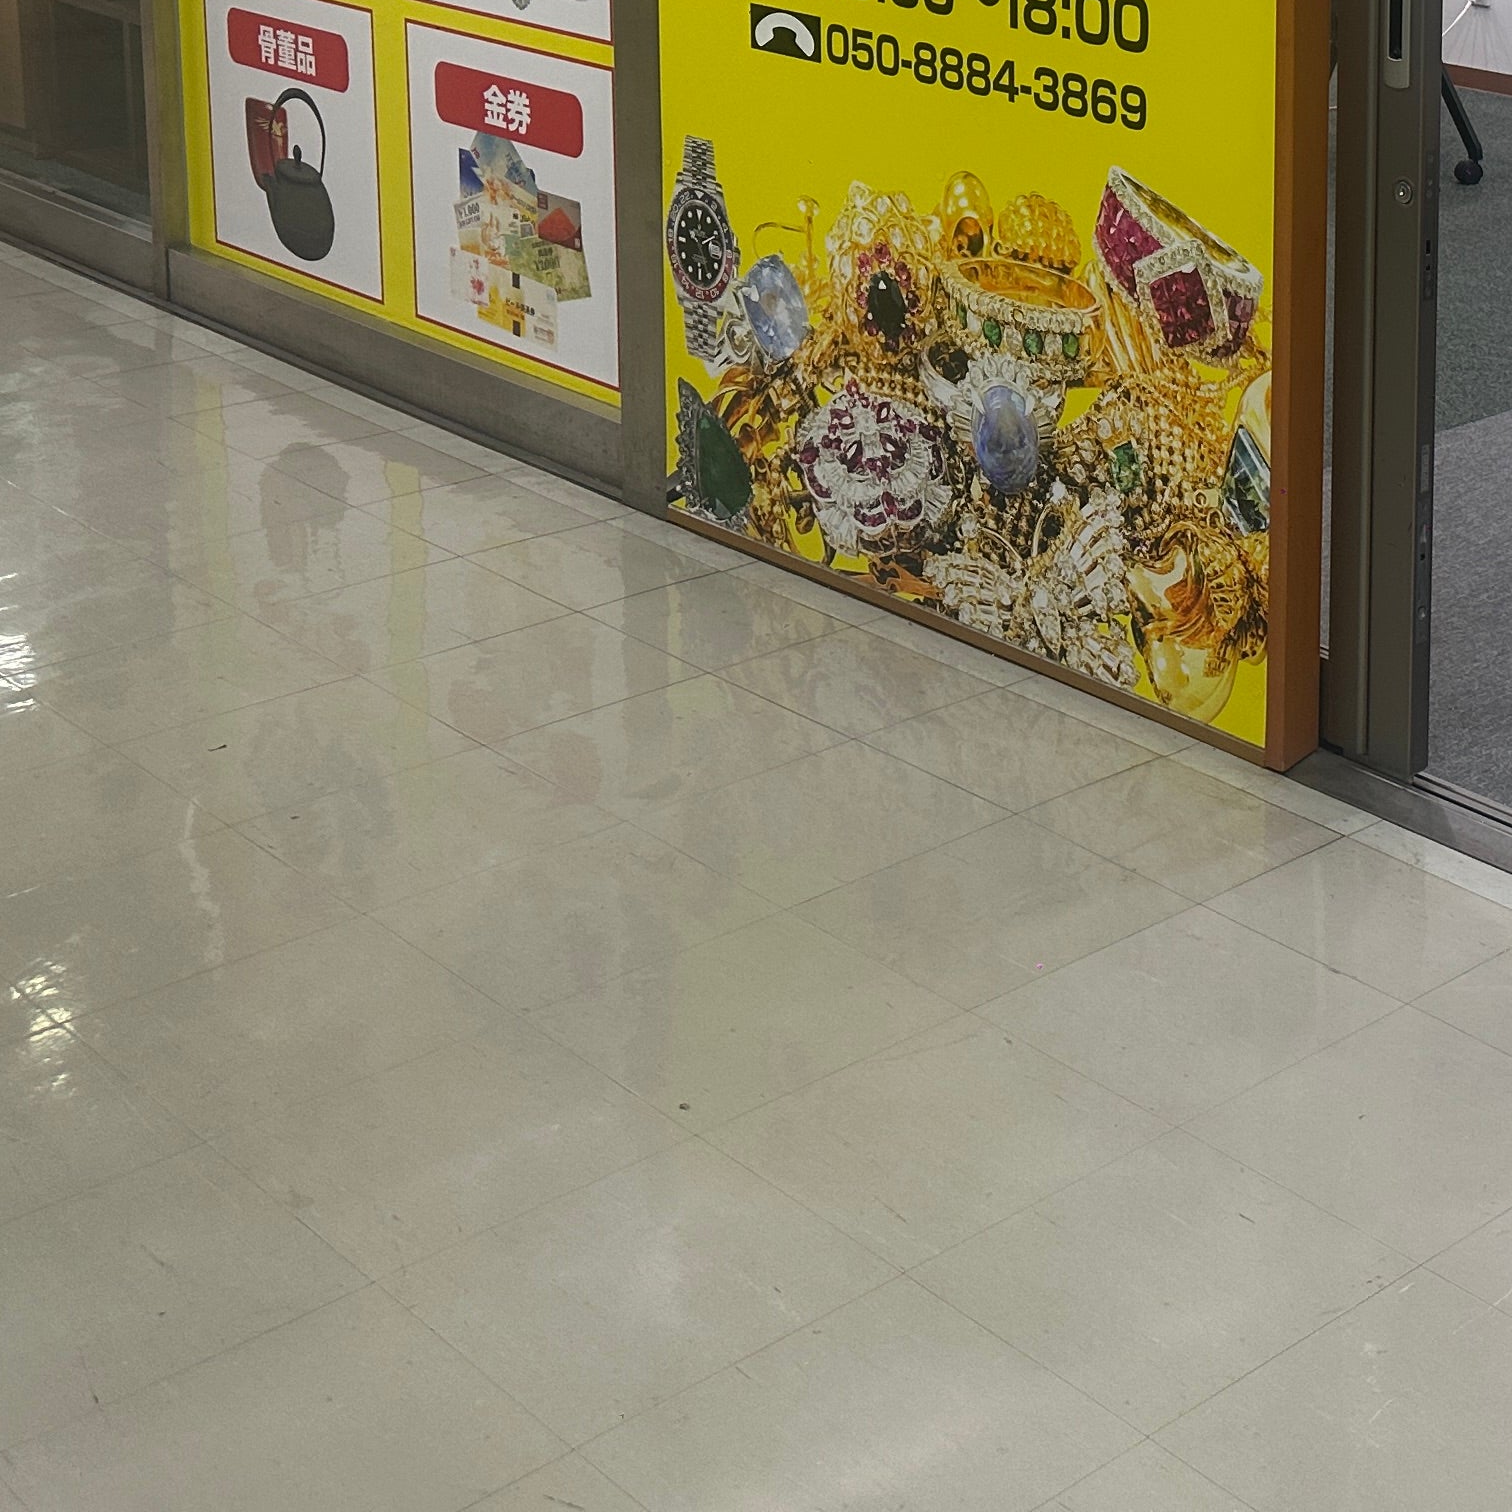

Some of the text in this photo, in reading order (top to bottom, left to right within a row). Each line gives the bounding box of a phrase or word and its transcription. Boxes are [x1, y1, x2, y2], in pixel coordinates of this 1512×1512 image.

[258, 24, 317, 78] 骨董品
[826, 23, 1148, 131] 050-8884-3869
[482, 84, 532, 136] 金券
